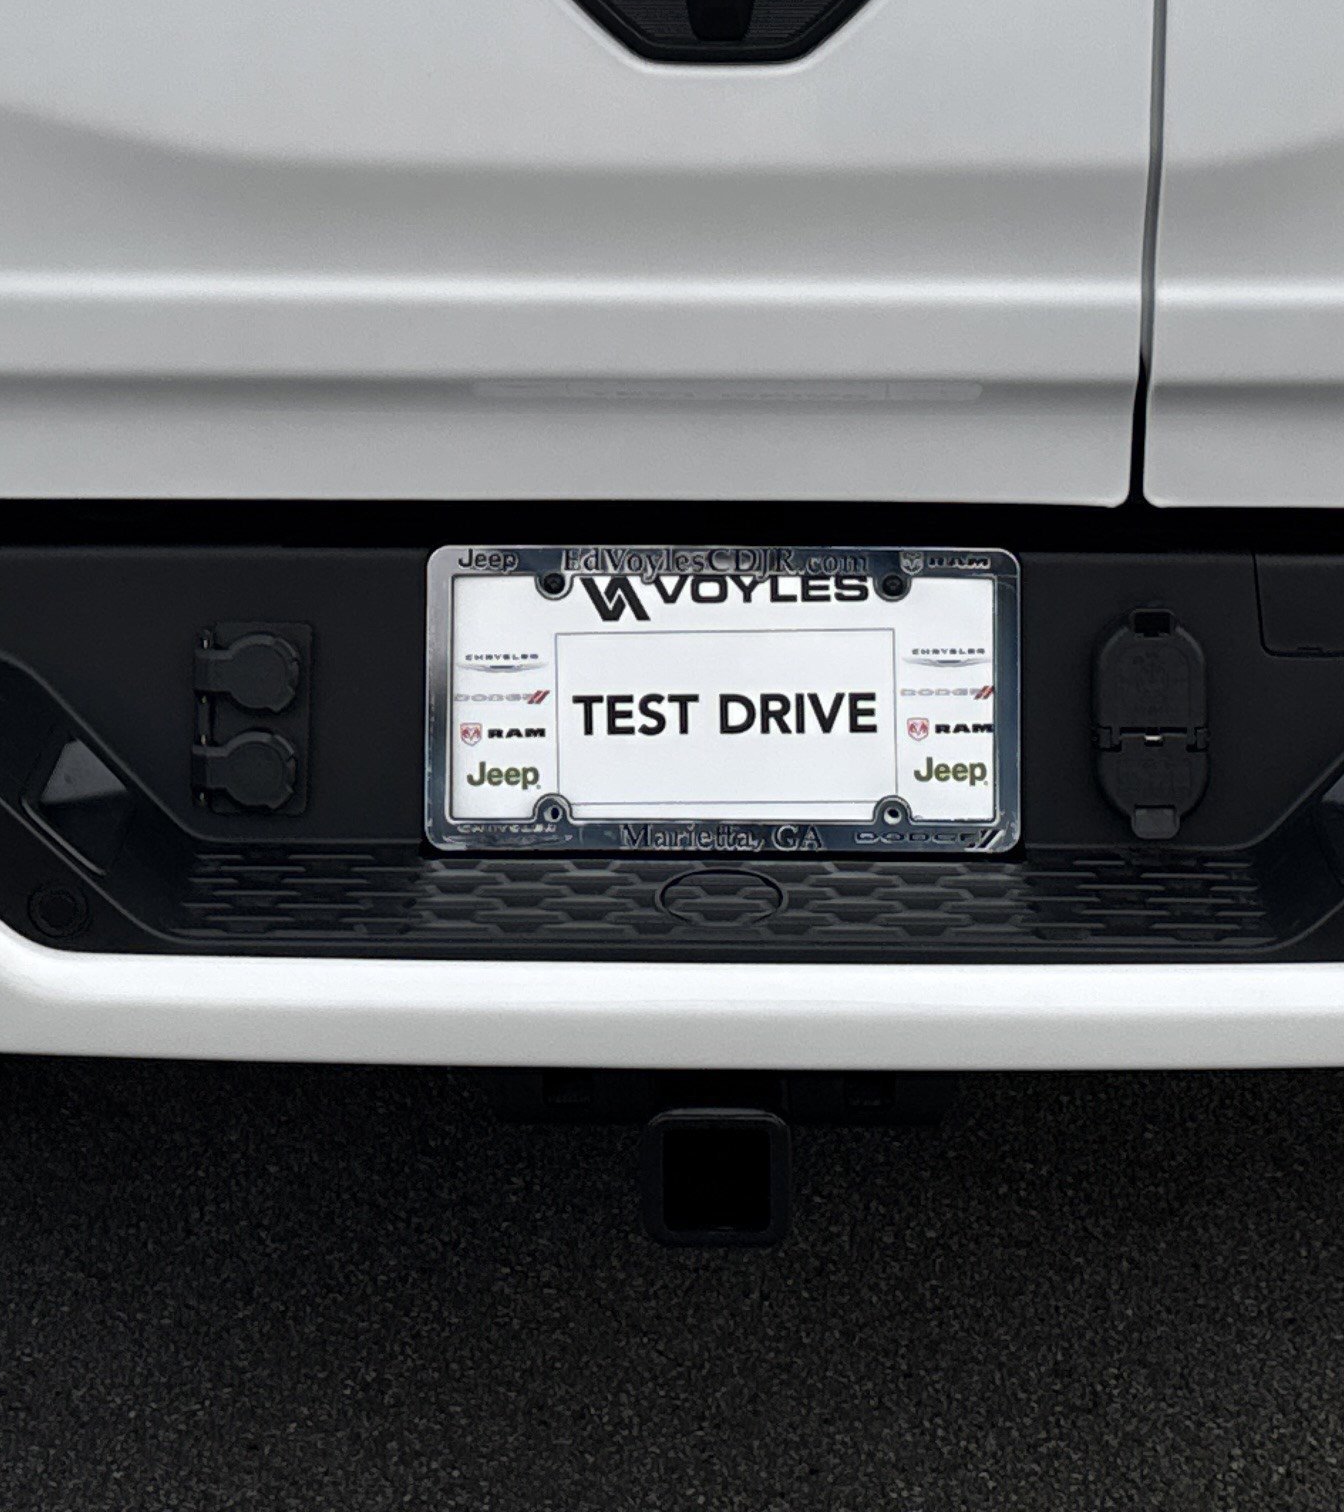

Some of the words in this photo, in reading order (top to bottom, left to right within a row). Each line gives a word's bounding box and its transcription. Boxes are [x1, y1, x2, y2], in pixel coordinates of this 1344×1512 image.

[457, 548, 520, 574] Jeep
[561, 547, 870, 586] EdVoylesCDJR.com
[926, 555, 992, 570] RAM
[656, 574, 870, 604] VOYLES
[573, 693, 699, 737] TEST
[719, 692, 878, 735] DRIVE
[934, 723, 994, 735] RAM
[487, 727, 547, 739] RAM
[466, 760, 541, 790] Jeep
[913, 756, 987, 787] Jeep
[618, 824, 765, 852] Marietta,
[772, 824, 825, 852] GA
